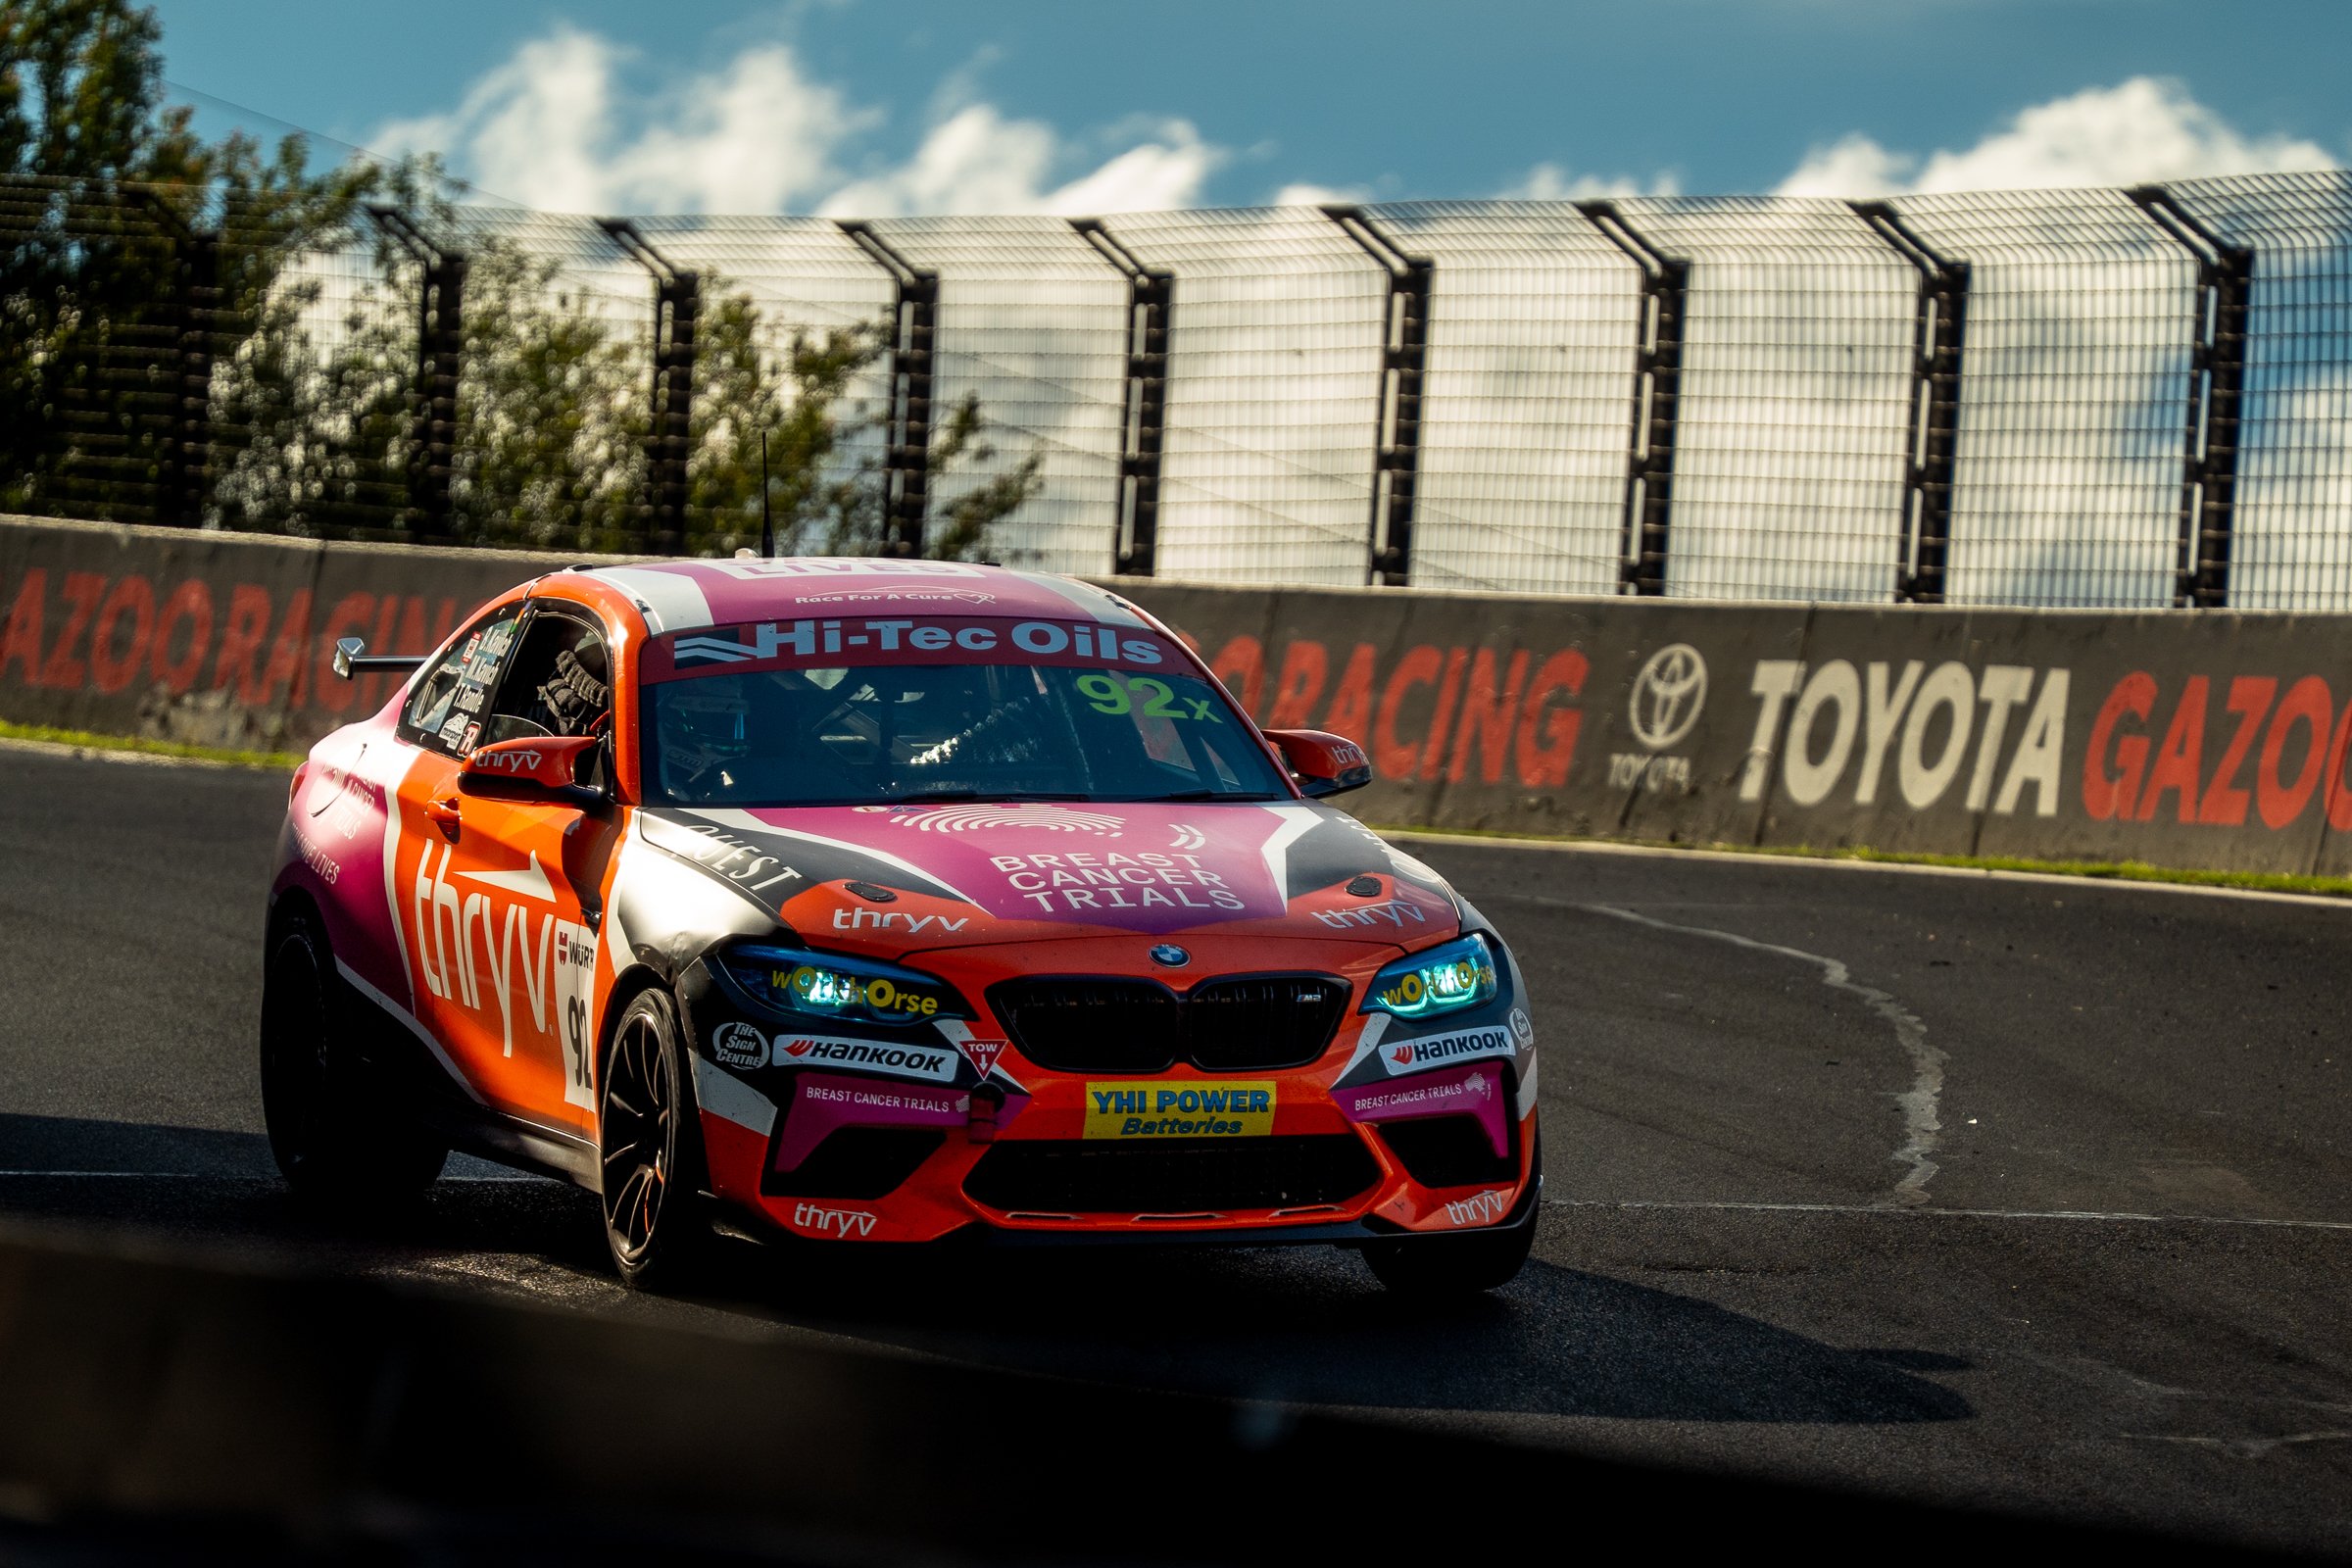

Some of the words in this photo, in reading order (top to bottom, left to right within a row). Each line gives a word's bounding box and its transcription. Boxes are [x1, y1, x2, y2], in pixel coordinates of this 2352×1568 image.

[795, 595, 843, 605] Race
[848, 593, 882, 602] For
[905, 592, 953, 602] Cure
[215, 583, 487, 713] RACIN
[756, 619, 998, 660] Hi-Tec
[1011, 621, 1163, 664] Oils
[1268, 640, 1590, 788] RACING
[1740, 658, 2071, 817] TOYOTA
[475, 750, 542, 772] thryv
[311, 850, 340, 885] LIVES
[683, 824, 803, 891] QUEST
[990, 852, 1201, 872] BREAST
[1007, 868, 1230, 891] CANCER
[1023, 887, 1246, 912] TRIALS
[832, 906, 969, 933] thryv
[1310, 903, 1426, 929] thryv
[416, 838, 554, 1058] thryv
[733, 1021, 756, 1037] THE
[725, 1035, 757, 1052] SIGN
[968, 1043, 998, 1053] TOW
[715, 1048, 764, 1066] CENTRE
[807, 1087, 852, 1102] BREAST
[854, 1092, 901, 1108] CANCER
[904, 1098, 950, 1113] TRIALS
[1093, 1090, 1147, 1114] YHI
[1156, 1090, 1270, 1113] POWER
[1355, 1095, 1389, 1111] BREAST
[1390, 1089, 1426, 1105] CANCER
[1428, 1083, 1462, 1100] TRIALS
[1120, 1116, 1243, 1136] Batteries
[794, 1202, 877, 1238] thryv
[1446, 1192, 1503, 1225] thryv
